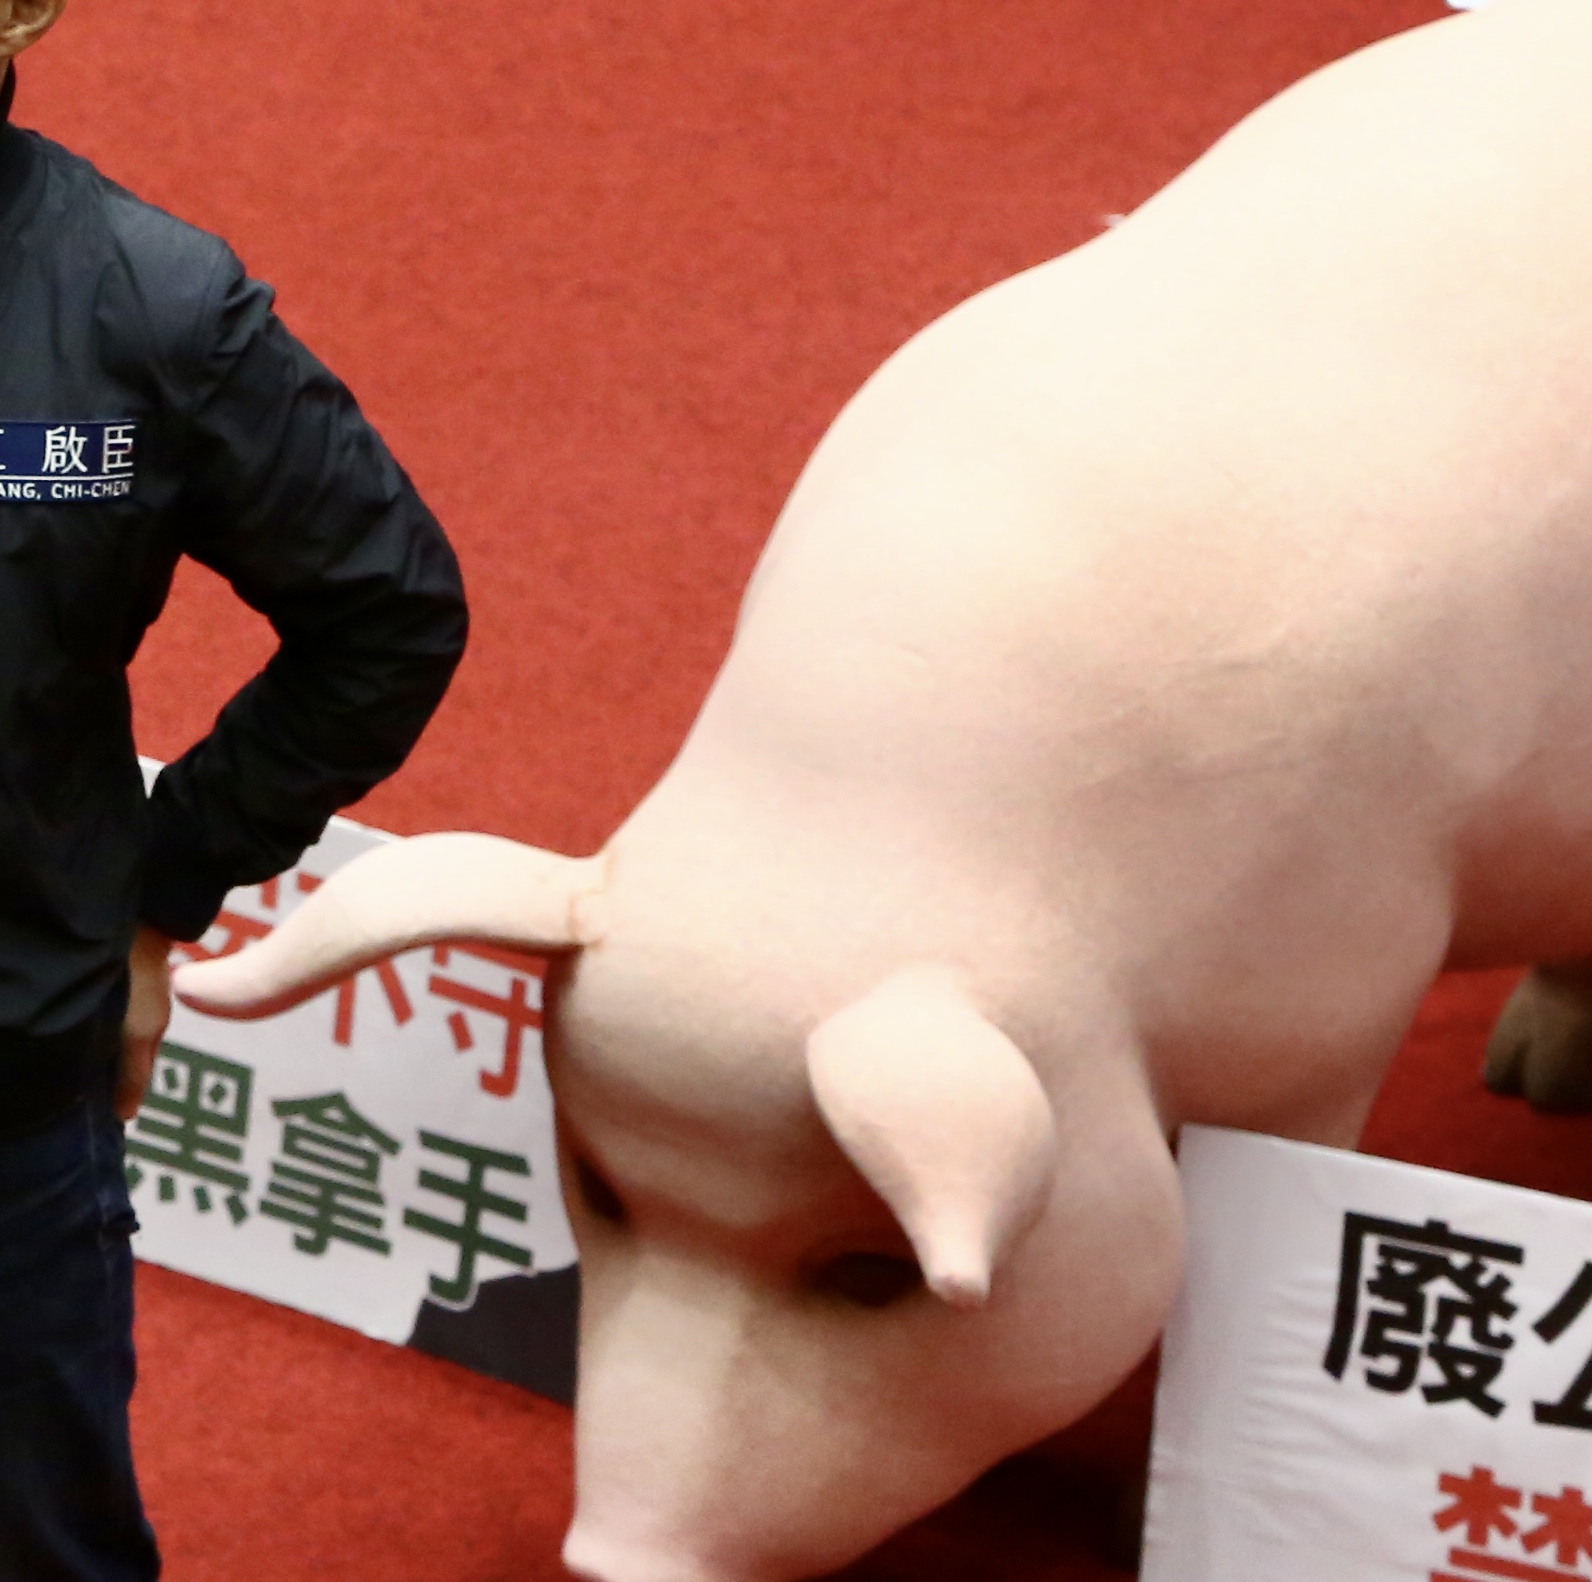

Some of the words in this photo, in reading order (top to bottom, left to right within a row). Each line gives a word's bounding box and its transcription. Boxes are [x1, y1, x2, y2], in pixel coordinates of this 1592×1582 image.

[51, 480, 131, 500] CHI-CHEN
[126, 1040, 535, 1303] 黑拿手
